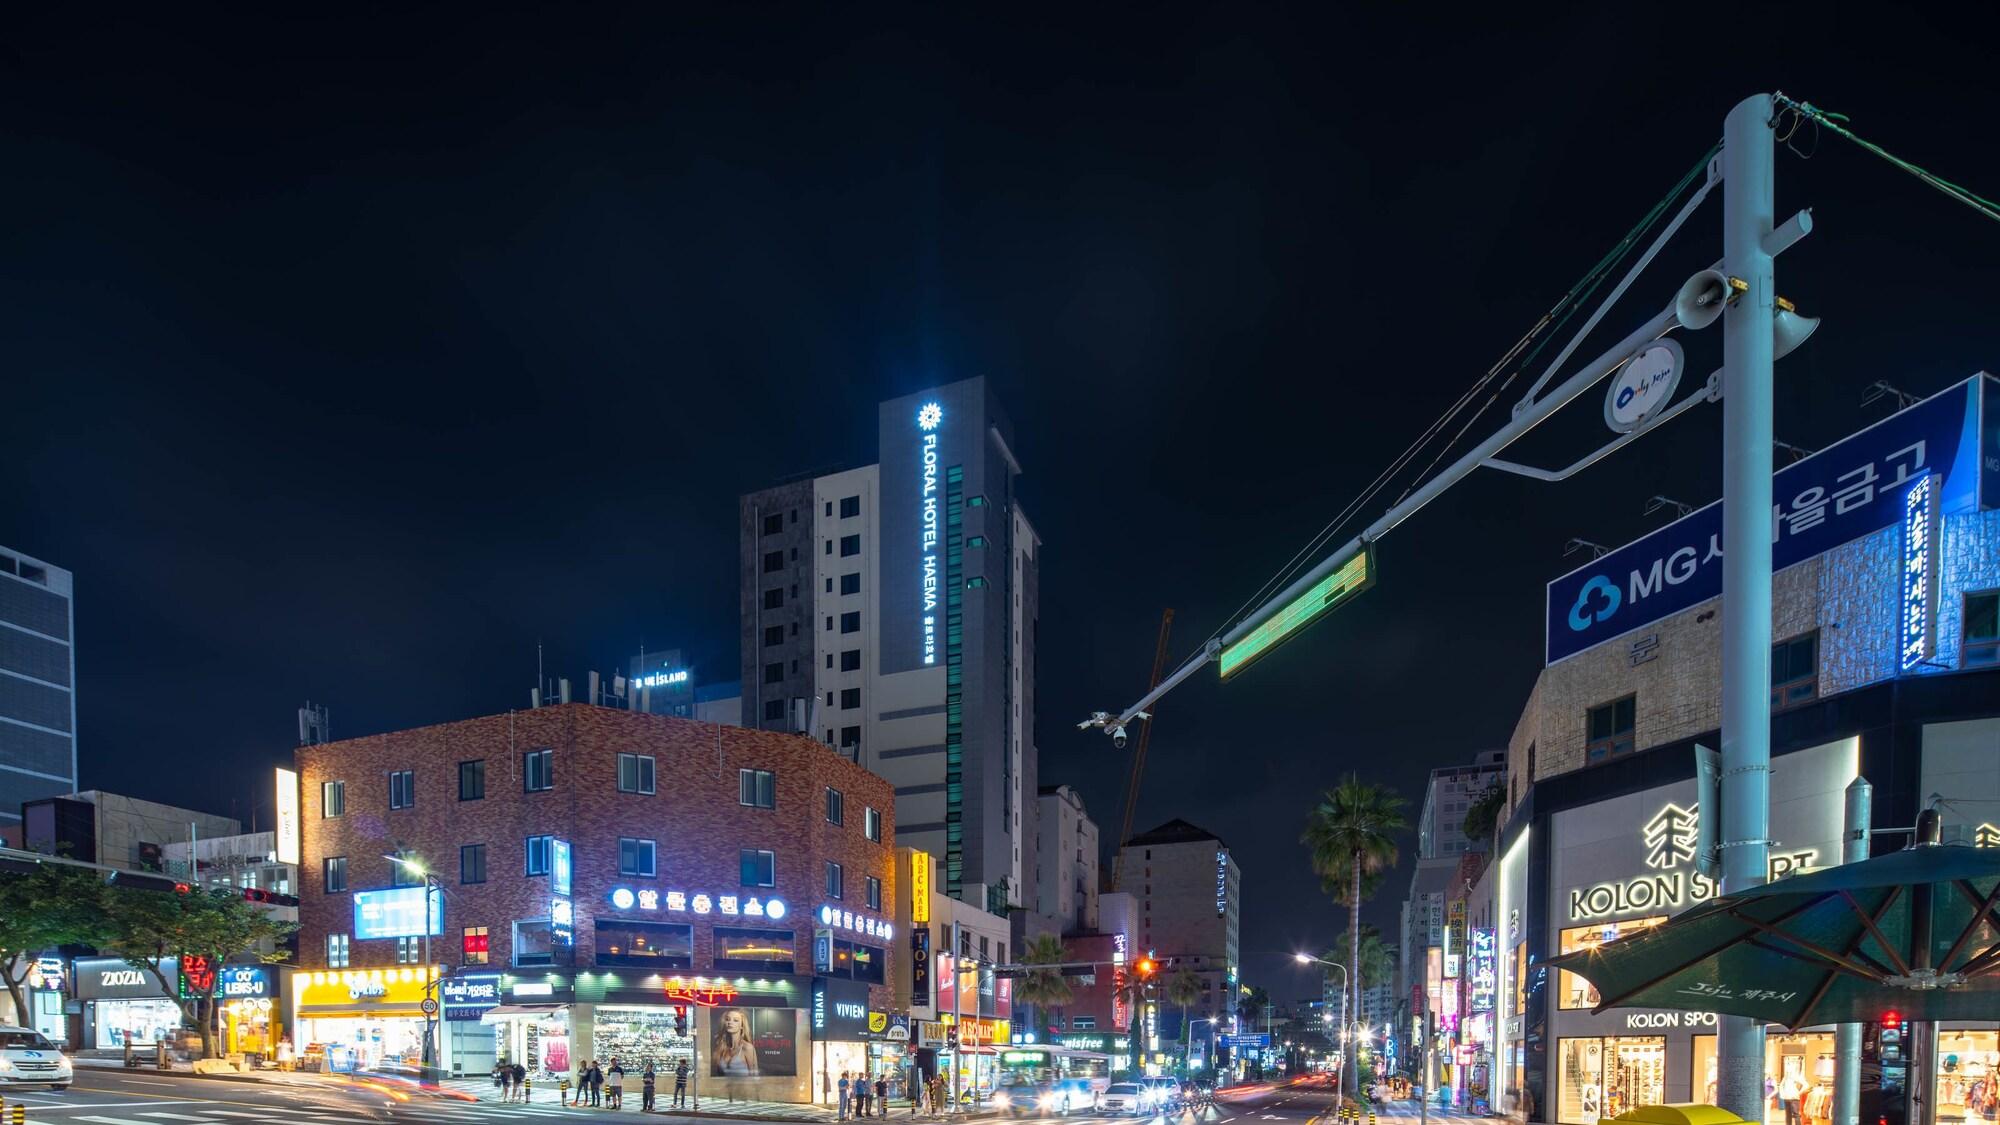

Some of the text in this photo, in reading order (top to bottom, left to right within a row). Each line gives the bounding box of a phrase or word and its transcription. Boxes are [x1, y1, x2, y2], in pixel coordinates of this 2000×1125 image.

[924, 434, 936, 611] FLORAL HOTEL HAEMA
[1571, 875, 1680, 918] KOLON
[101, 971, 146, 986] ZIOZIA
[1739, 989, 1797, 1002] 제주시
[424, 1002, 435, 1010] 50
[815, 991, 824, 1028] VIVIEN
[836, 1003, 865, 1018] VIVIEN
[1627, 1013, 1679, 1028] KOLON
